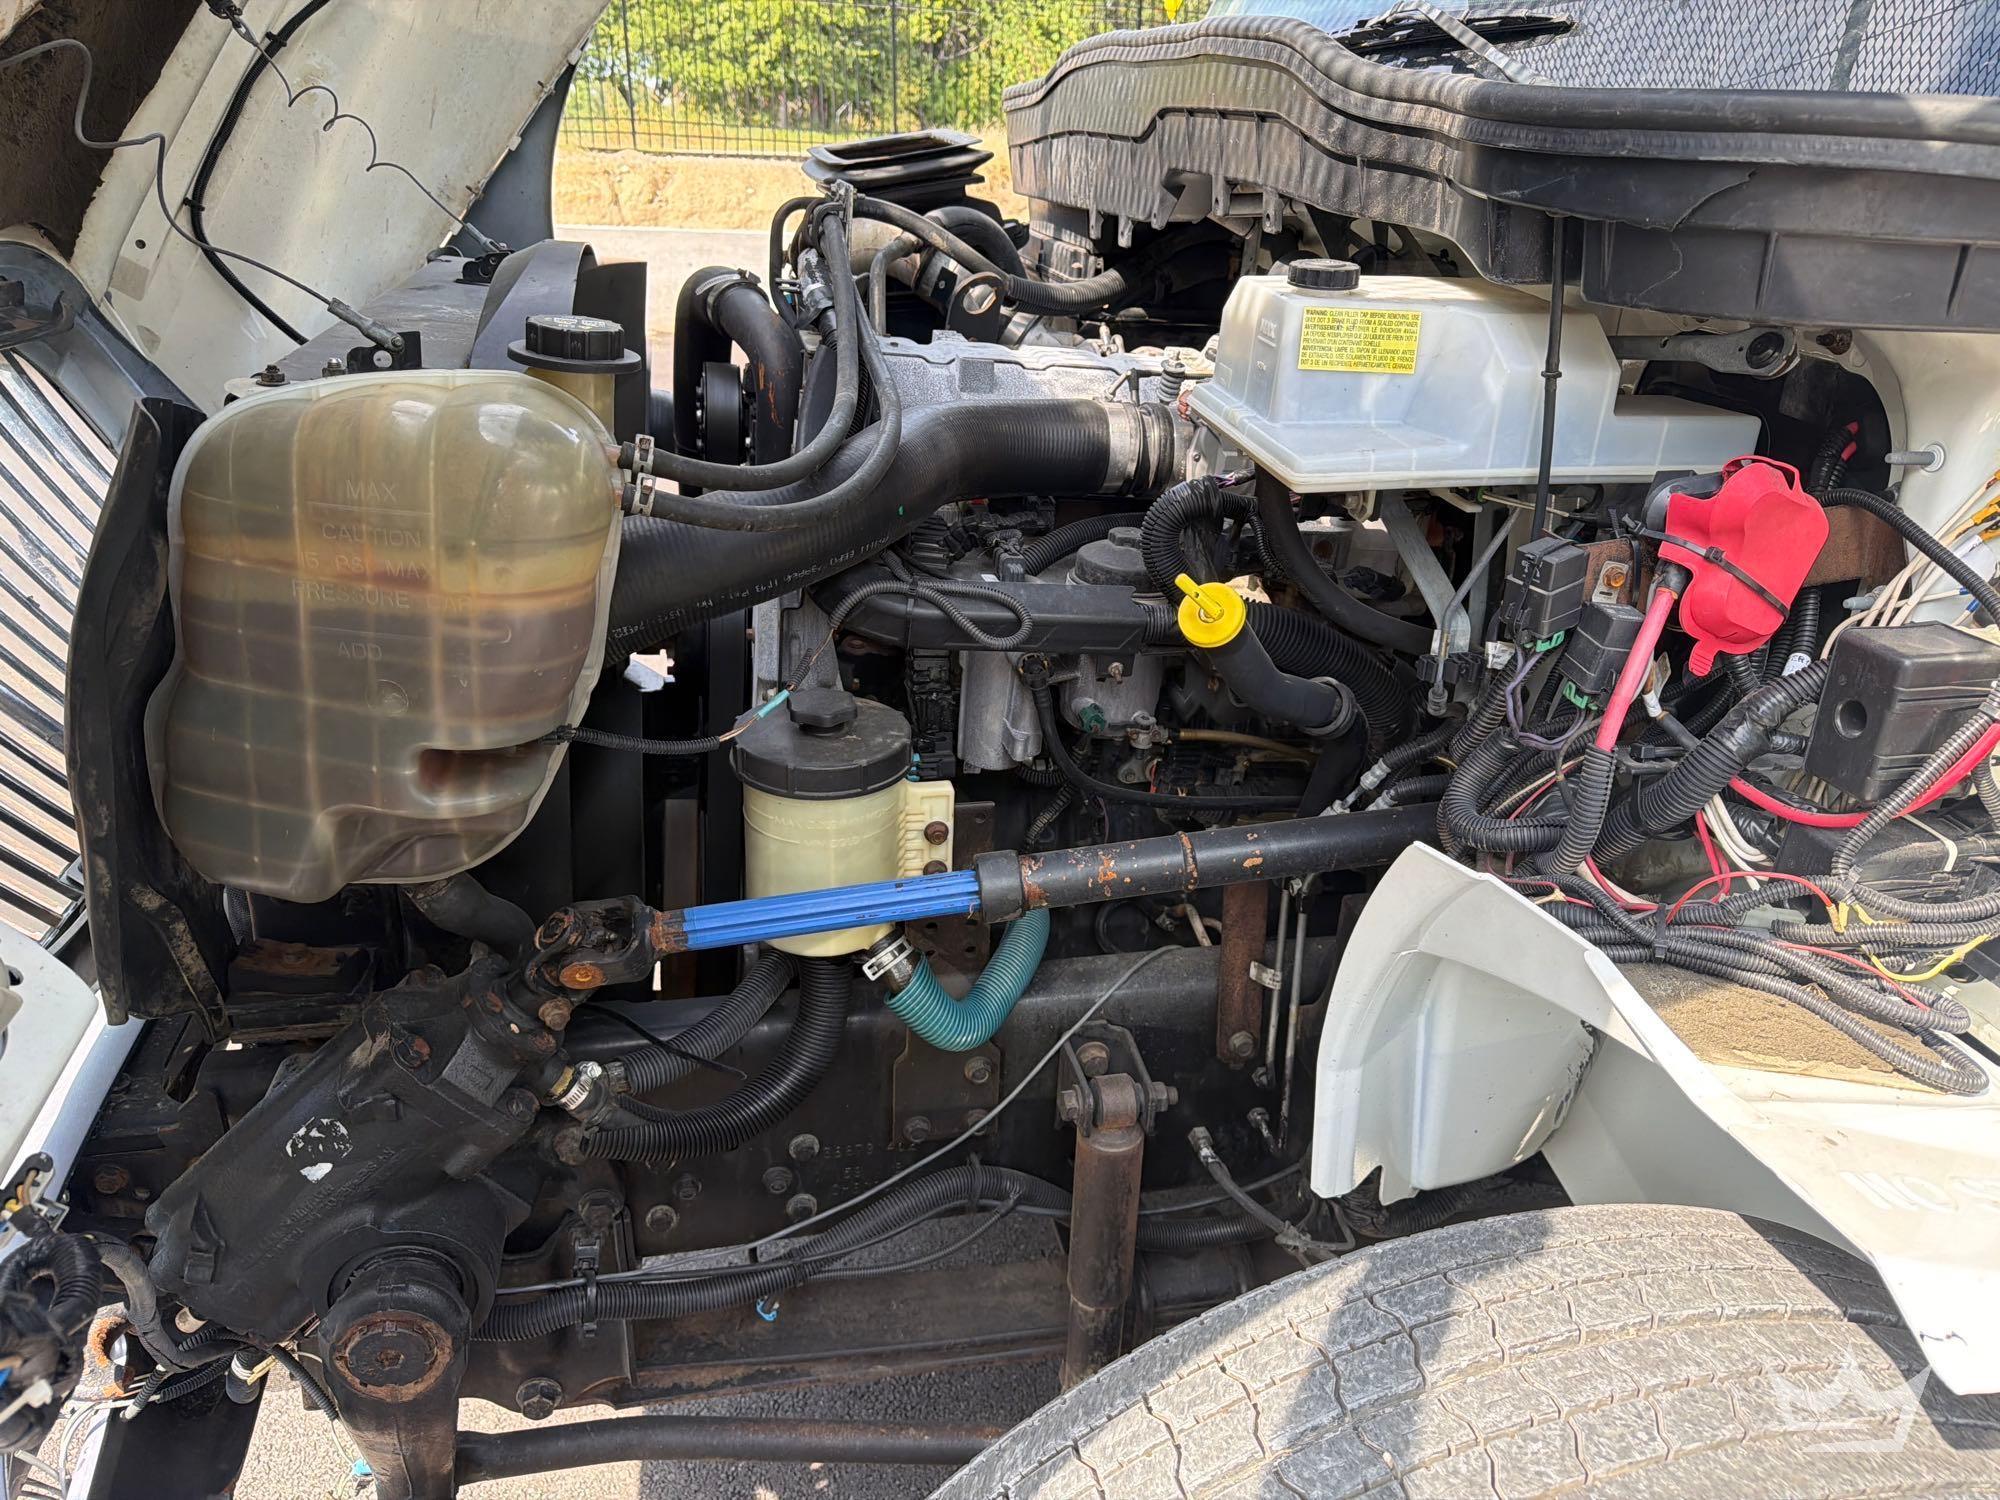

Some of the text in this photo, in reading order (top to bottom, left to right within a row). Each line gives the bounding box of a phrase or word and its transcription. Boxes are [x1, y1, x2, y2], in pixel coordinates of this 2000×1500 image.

[346, 479, 398, 502] MAX
[322, 523, 422, 547] CAUTION
[292, 579, 410, 609] PRESSURE
[338, 641, 383, 661] ADD
